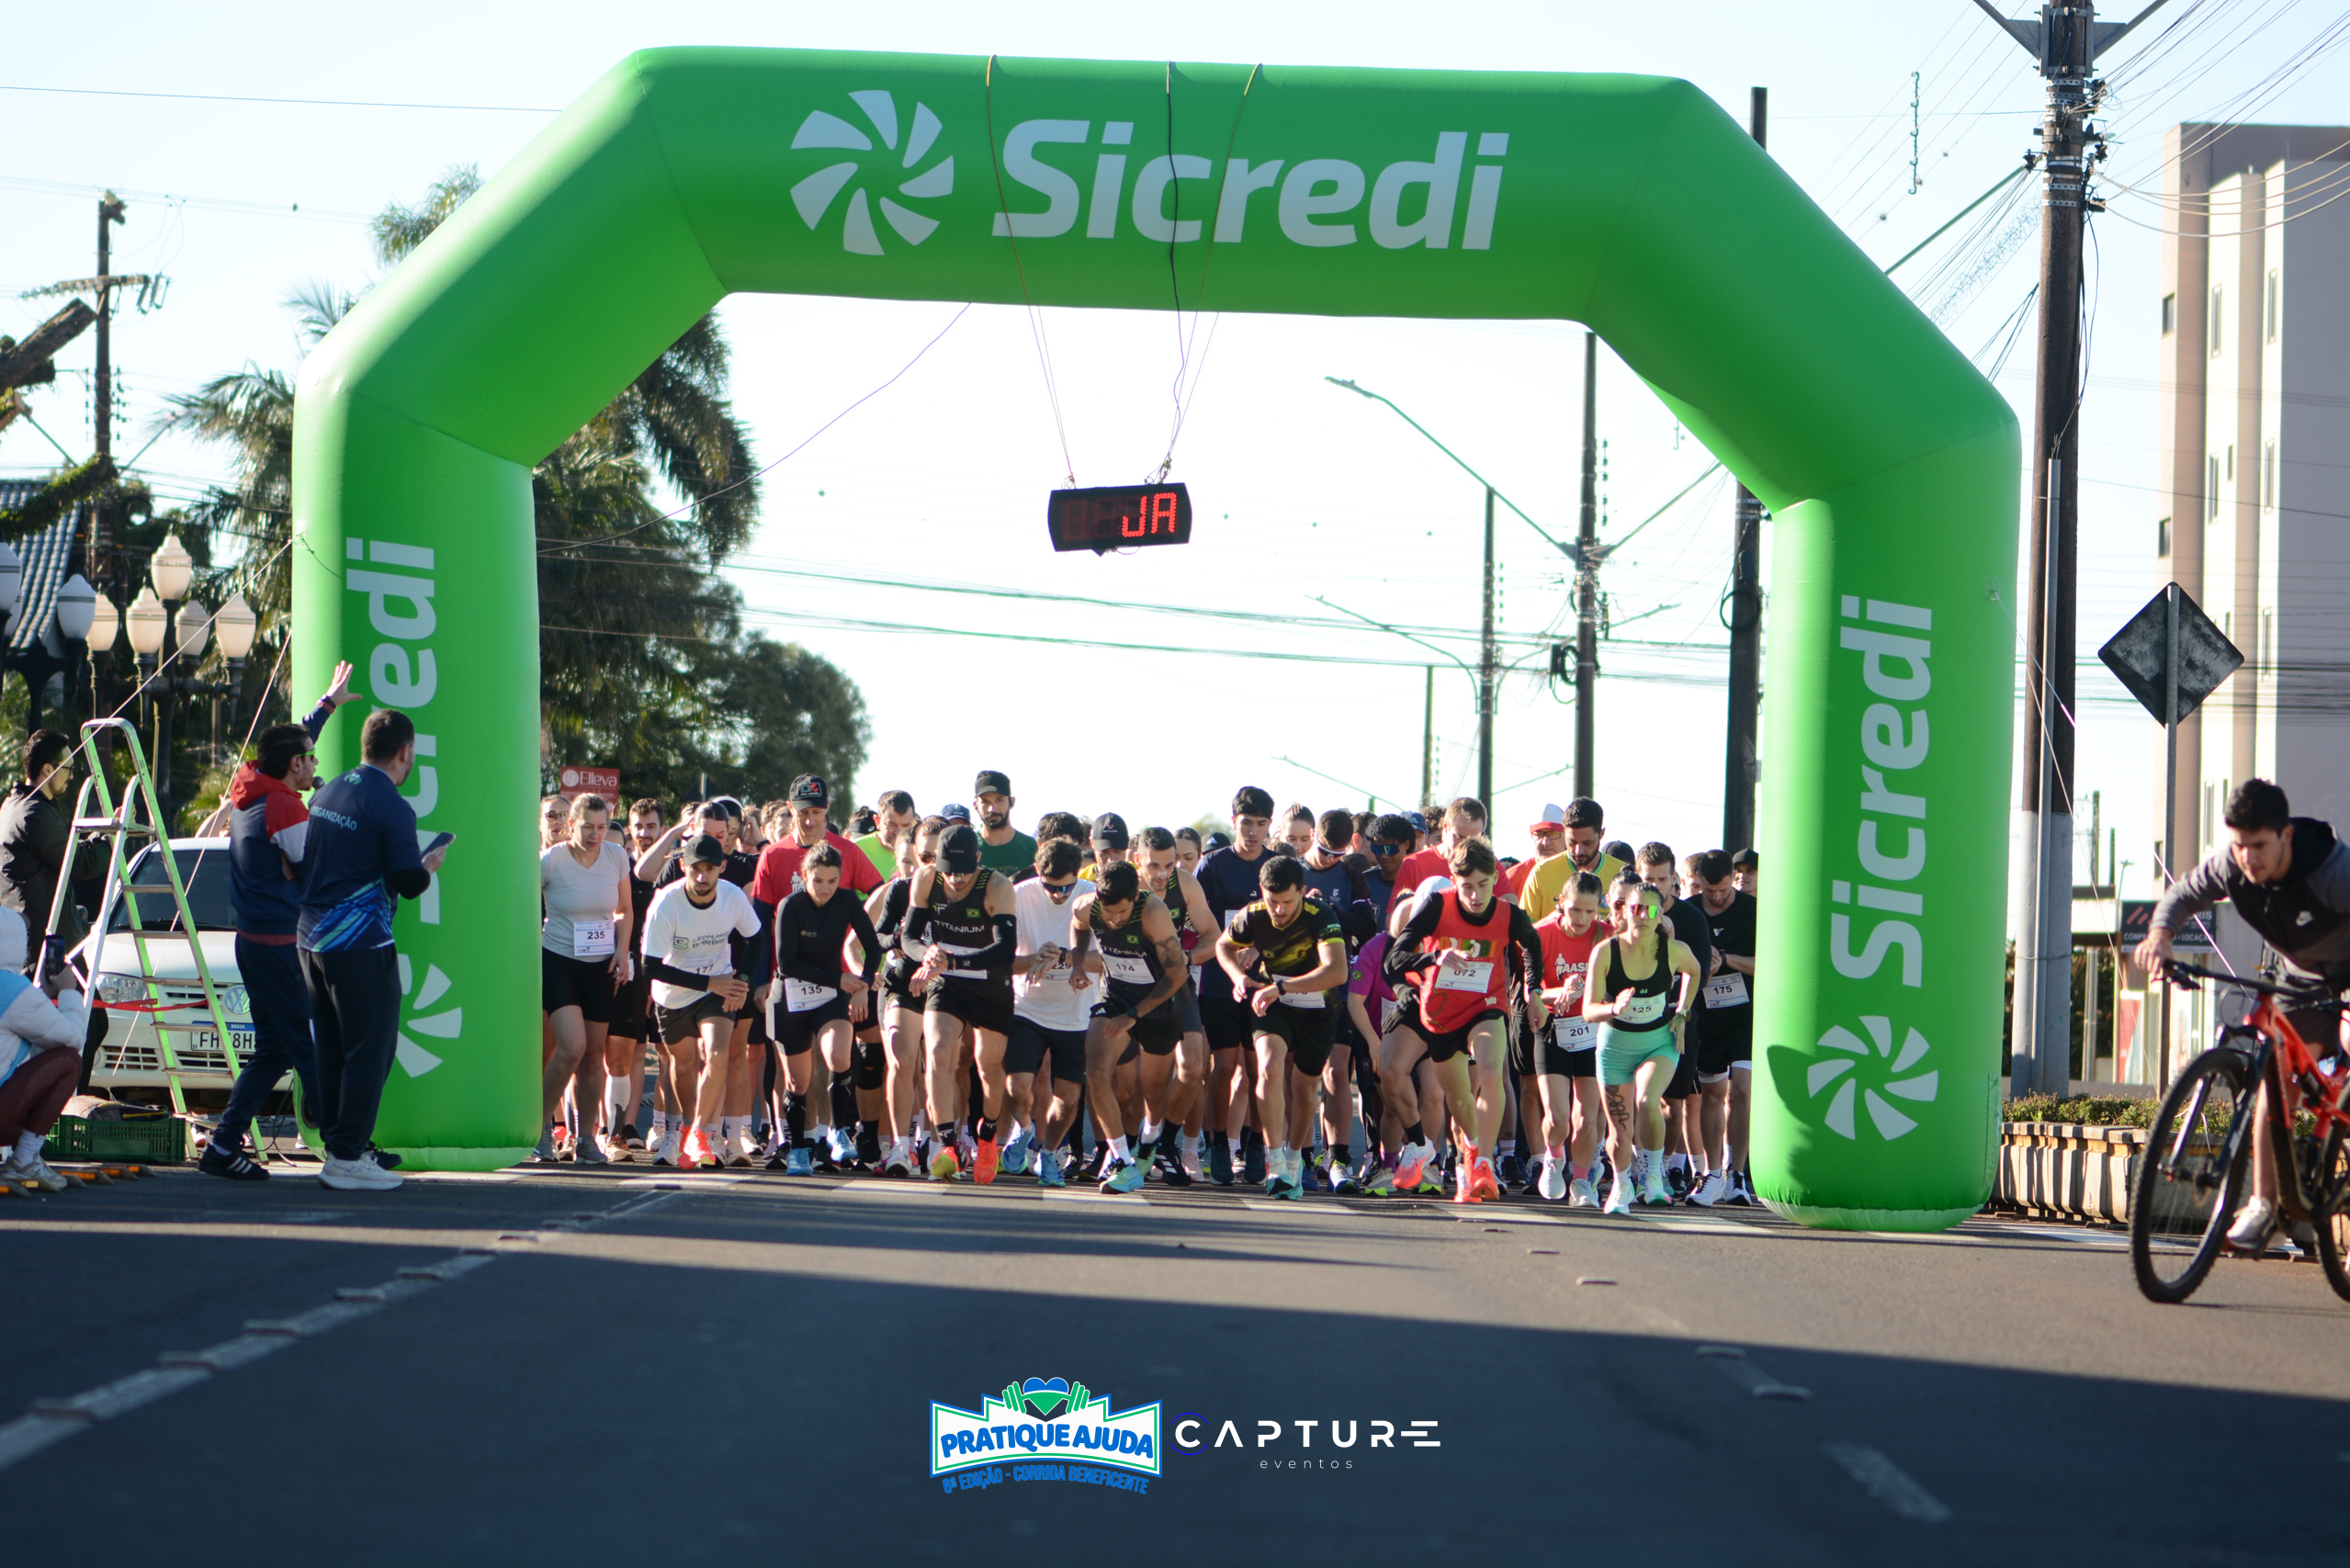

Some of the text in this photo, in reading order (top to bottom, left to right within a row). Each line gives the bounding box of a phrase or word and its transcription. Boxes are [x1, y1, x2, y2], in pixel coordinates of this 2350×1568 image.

[992, 119, 1509, 250] Sicredi
[1122, 492, 1177, 537] JA
[580, 772, 617, 787] Elleva
[1830, 594, 1932, 988] Sicredi
[311, 806, 357, 830] ORGANIZAÇÃO
[934, 919, 985, 932] TITANIUM
[587, 931, 605, 940] 235
[695, 964, 714, 974] 177
[1115, 964, 1135, 972] 174
[801, 986, 822, 995] 135
[1713, 985, 1733, 995] 175
[1631, 1005, 1652, 1013] 125
[1570, 1026, 1589, 1037] 201
[199, 1032, 253, 1049] FH8H
